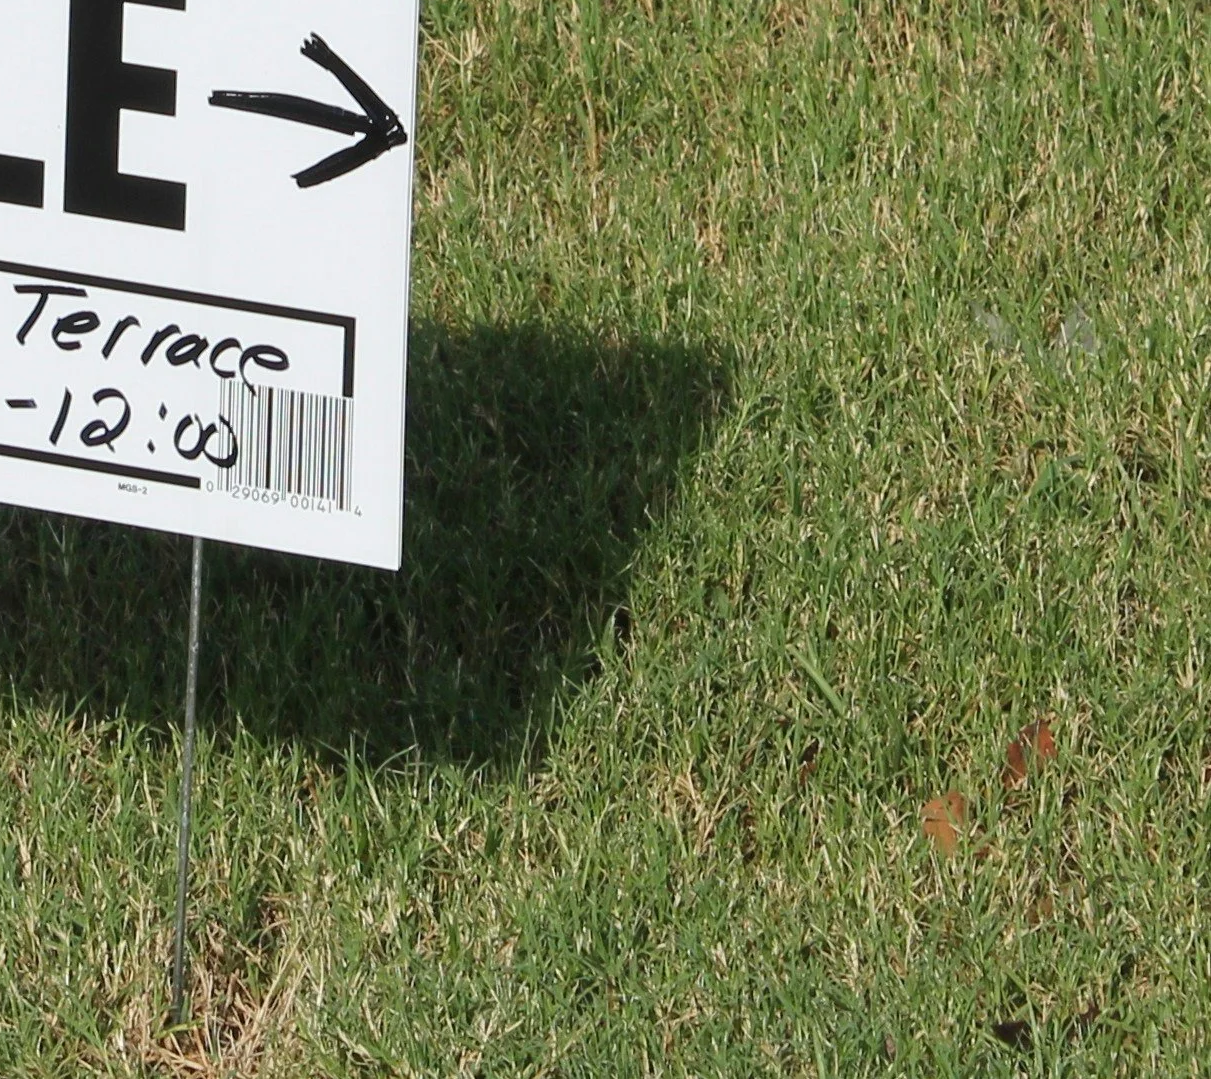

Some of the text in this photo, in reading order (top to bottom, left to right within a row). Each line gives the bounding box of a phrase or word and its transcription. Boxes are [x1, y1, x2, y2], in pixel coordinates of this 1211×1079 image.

[15, 283, 289, 396] Terrace
[206, 480, 363, 518] 0 29069 00141 4
